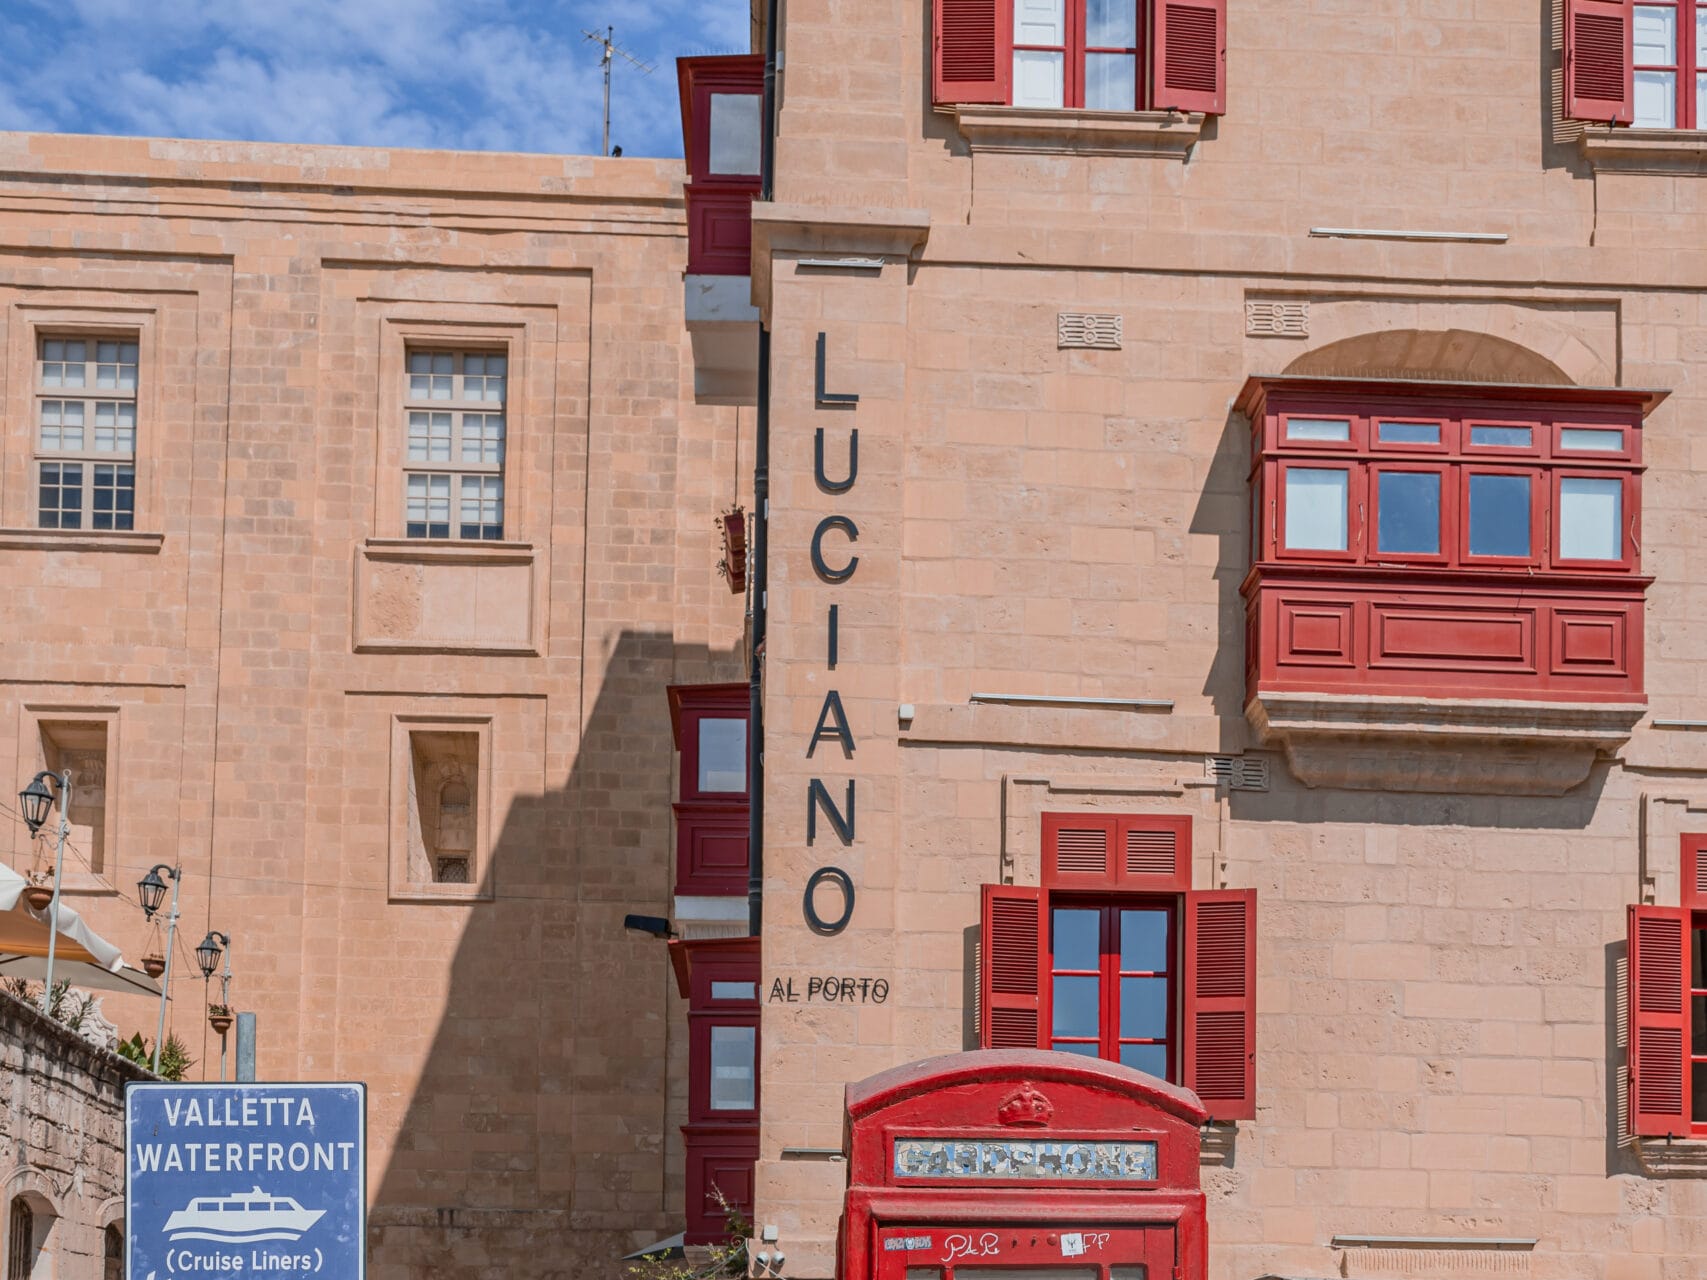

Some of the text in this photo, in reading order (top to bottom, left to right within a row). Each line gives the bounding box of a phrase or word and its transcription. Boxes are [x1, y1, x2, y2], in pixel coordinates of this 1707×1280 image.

[806, 332, 859, 932] LUCIANO
[769, 976, 889, 1004] AL PORTO
[163, 1097, 316, 1127] VALLETTA
[136, 1142, 355, 1172] WATERFRONT
[898, 1142, 1149, 1176] CARDPHONE
[166, 1247, 323, 1274] (Cruise Liners)
